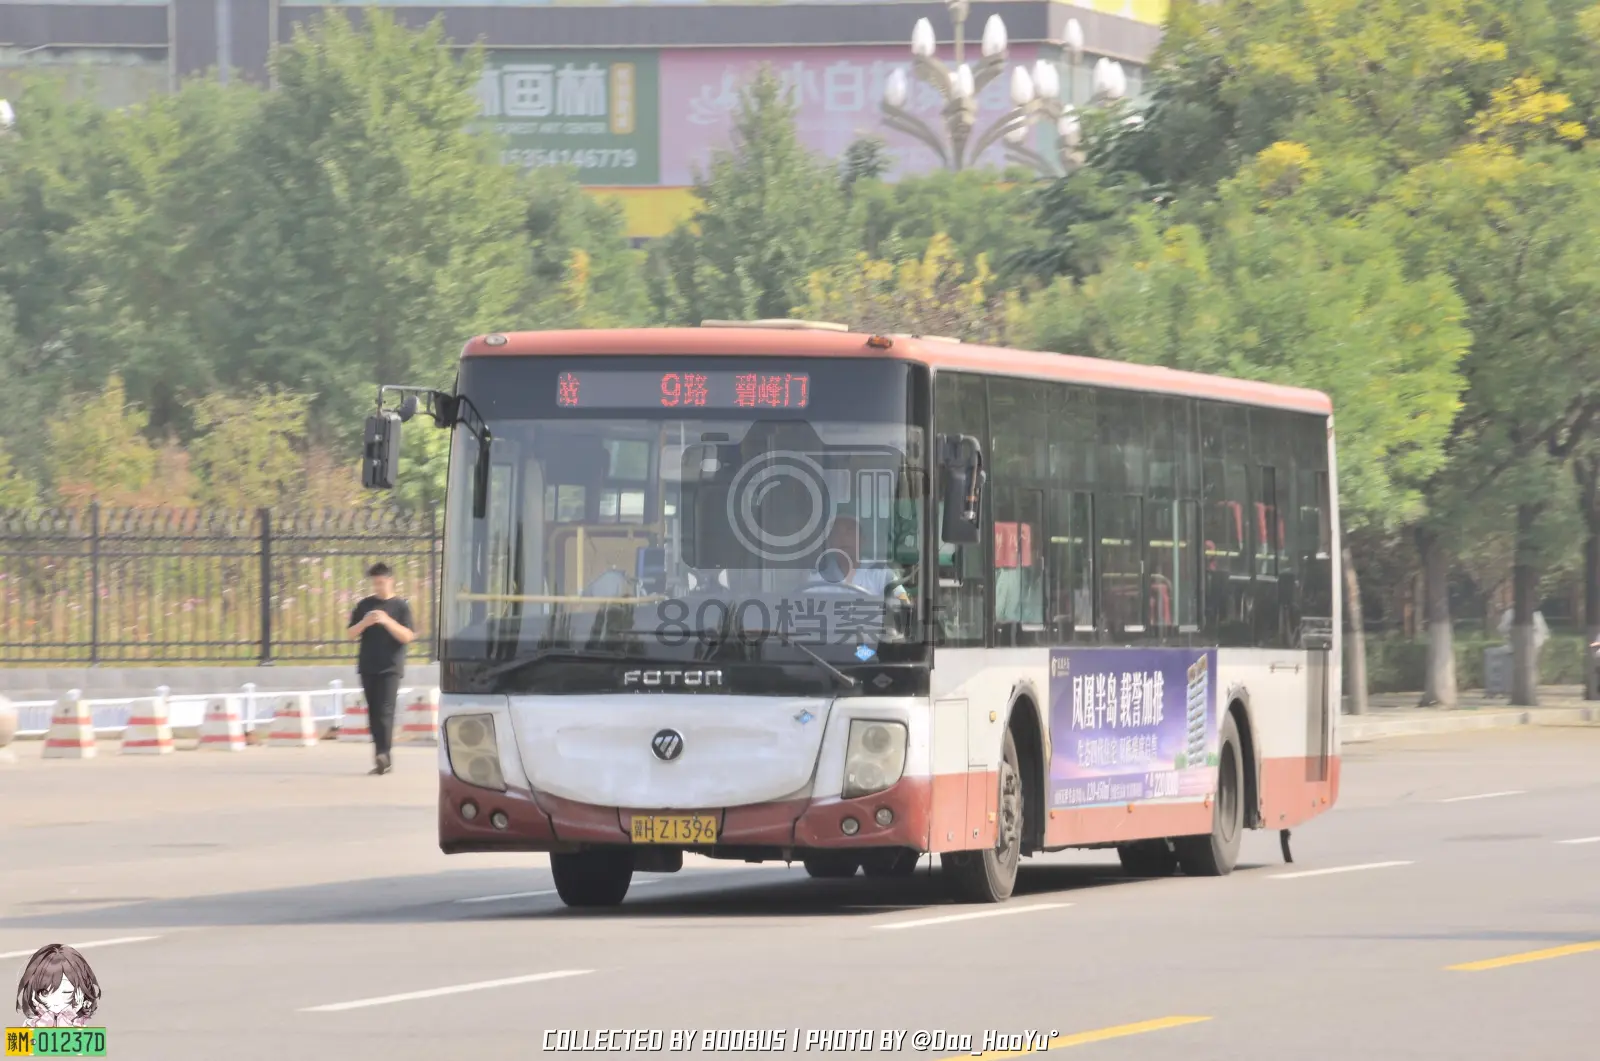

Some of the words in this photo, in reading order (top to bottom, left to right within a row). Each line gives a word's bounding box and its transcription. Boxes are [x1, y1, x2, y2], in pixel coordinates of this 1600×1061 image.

[660, 373, 708, 406] 9路
[624, 670, 722, 686] FOTON
[1072, 672, 1117, 731] 凤凰半岛
